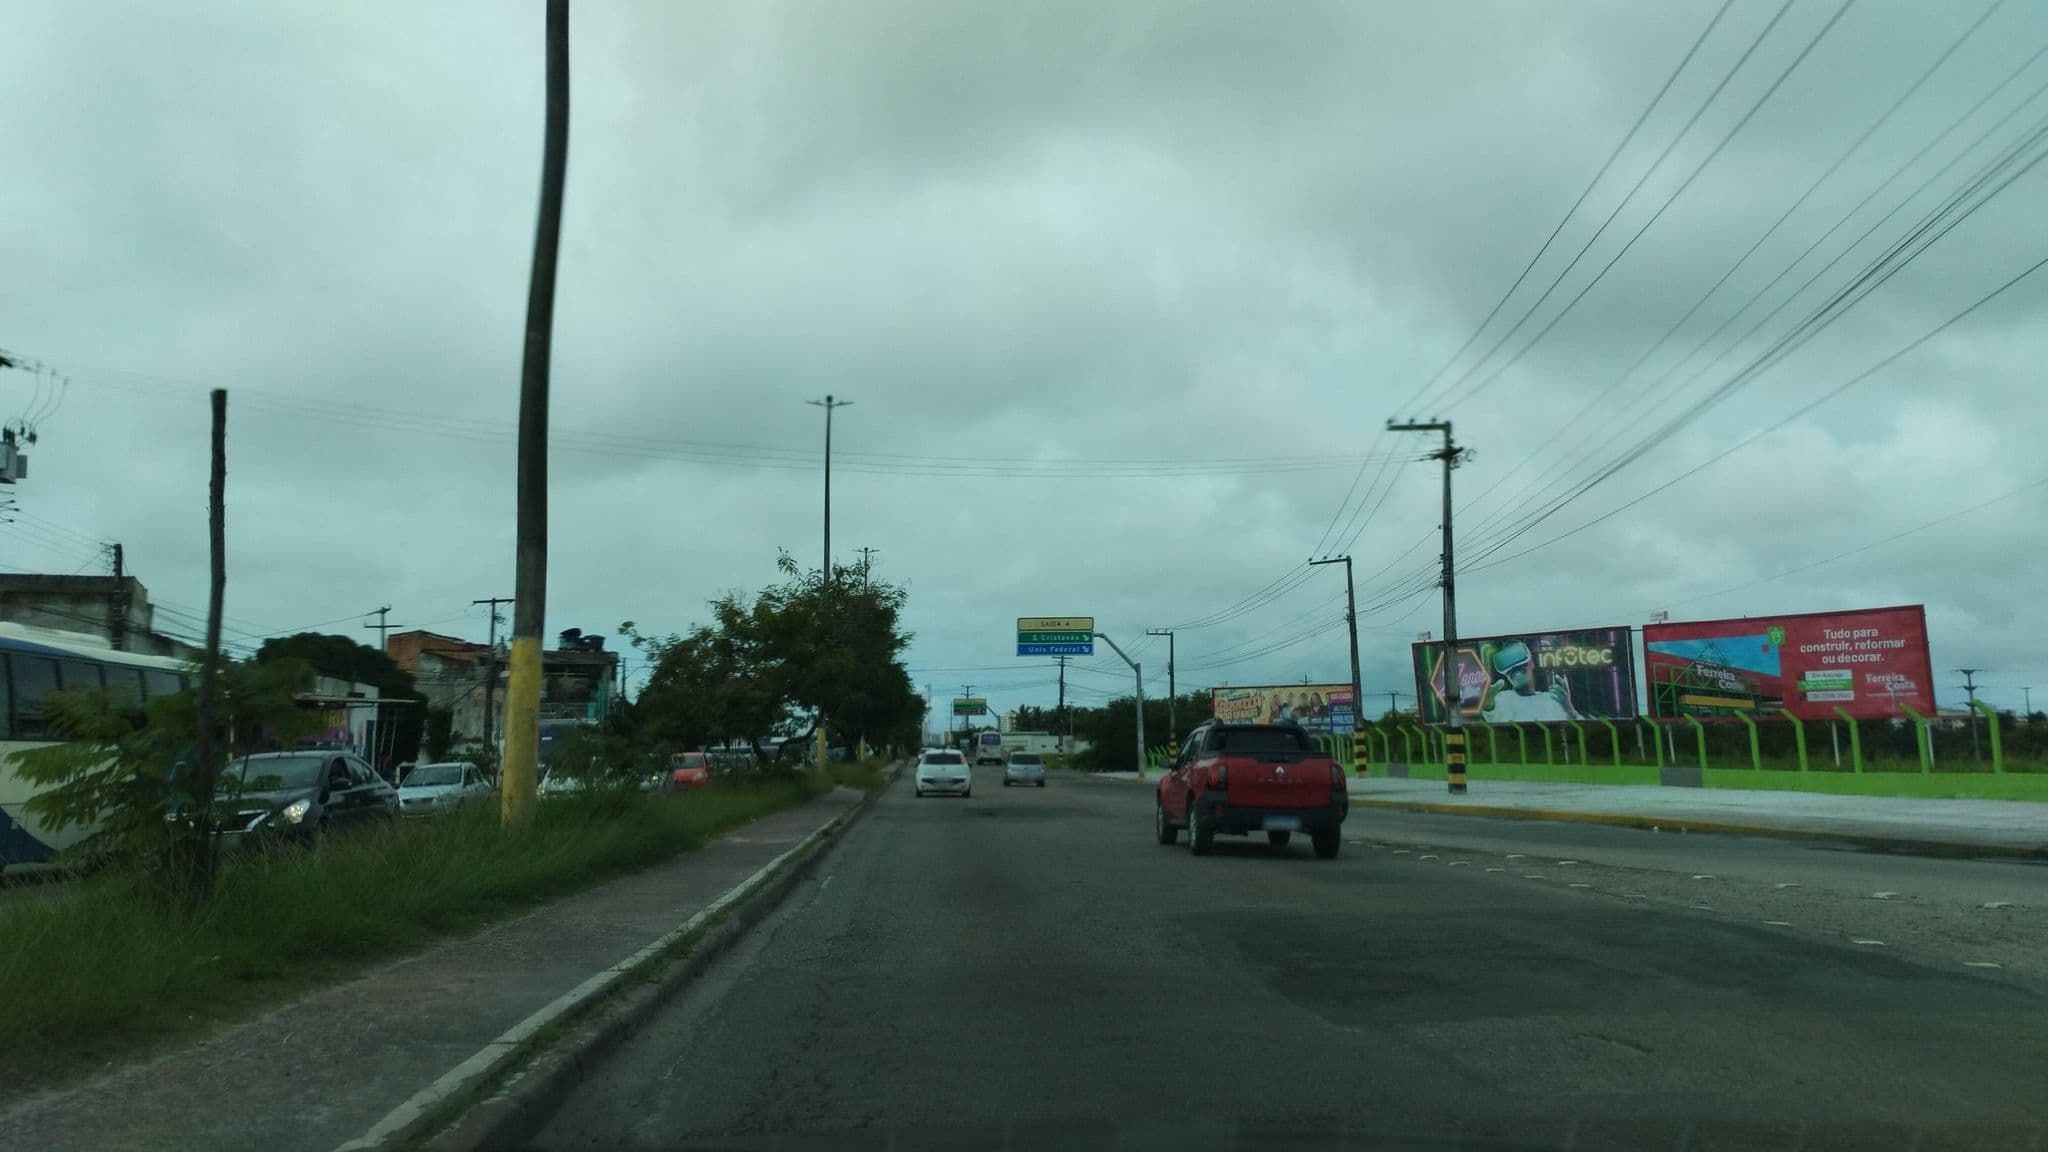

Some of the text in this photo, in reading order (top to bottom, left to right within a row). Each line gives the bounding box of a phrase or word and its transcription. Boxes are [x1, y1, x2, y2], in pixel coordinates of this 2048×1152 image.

[1824, 628, 1878, 640] Tudo para
[1049, 645, 1080, 653] Federal
[1799, 639, 1905, 654] construir, reformar
[1822, 653, 1884, 664] ou decorar.
[1696, 664, 1736, 681] Ferreira
[1867, 673, 1904, 683] Ferreira
